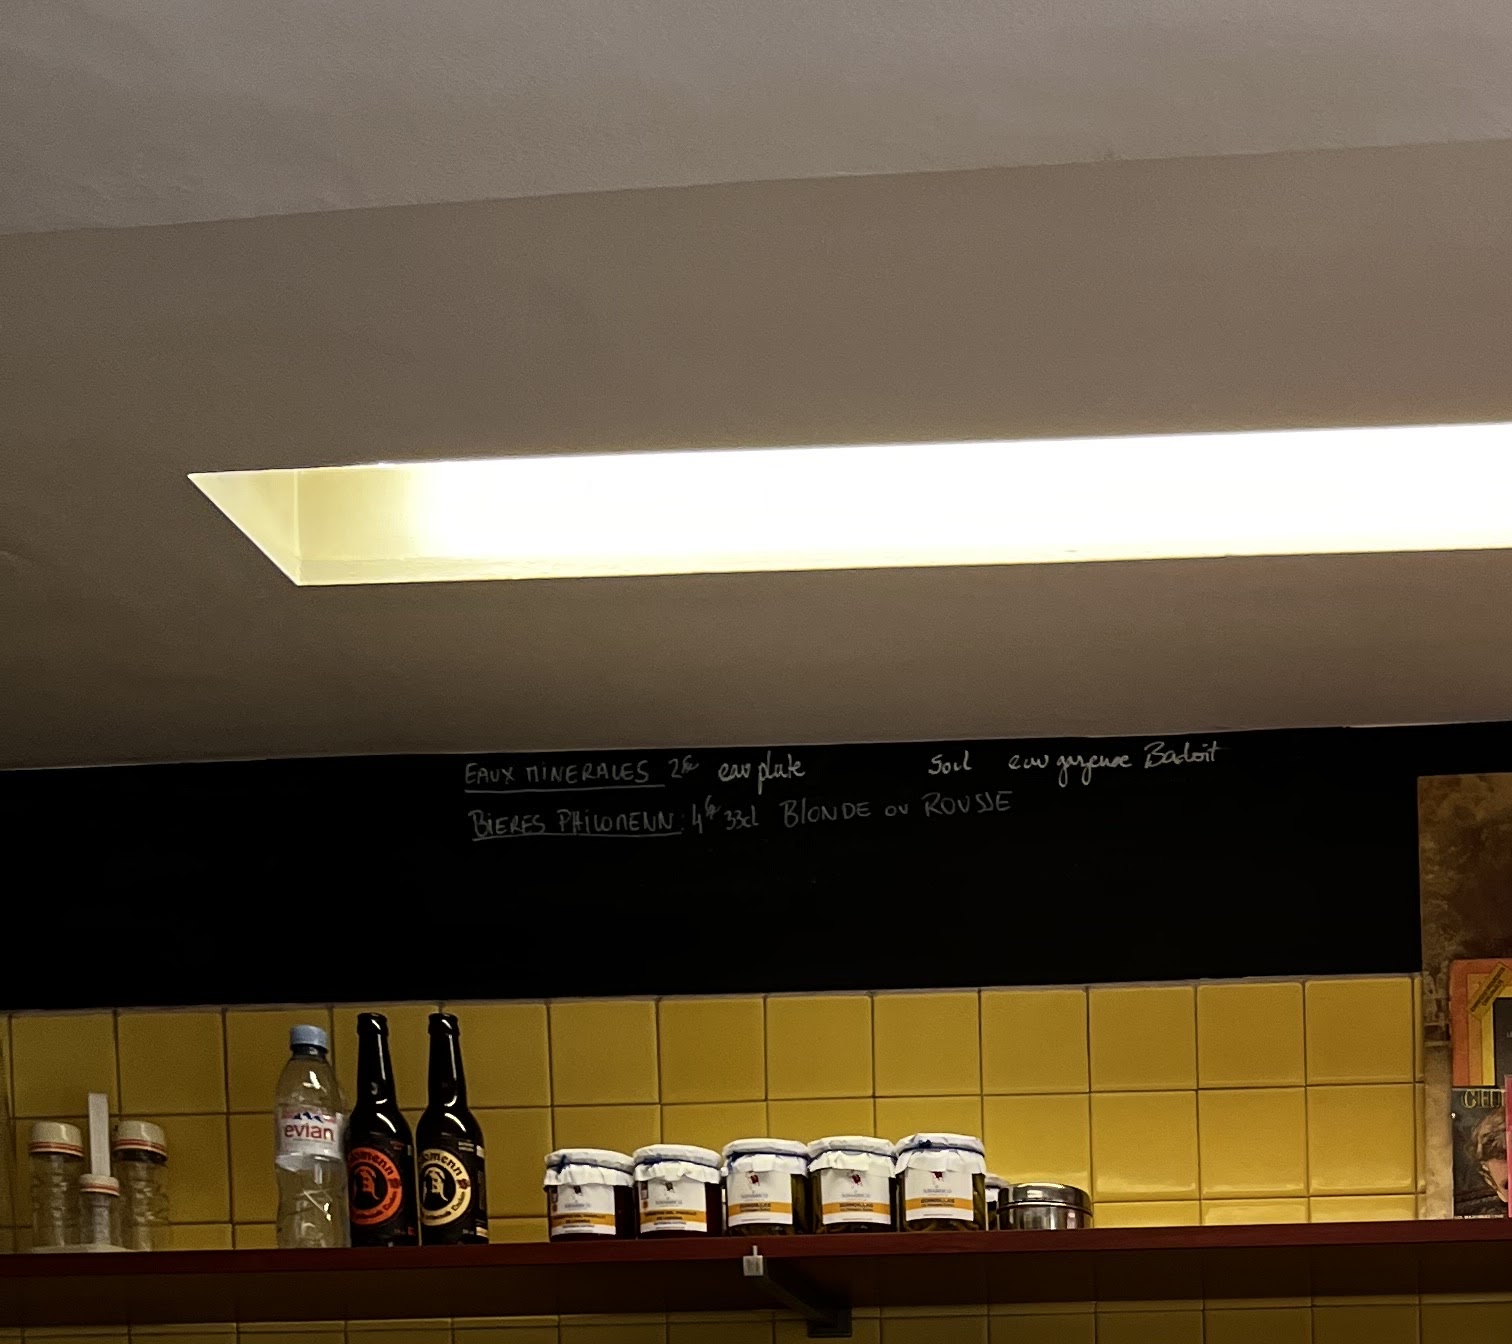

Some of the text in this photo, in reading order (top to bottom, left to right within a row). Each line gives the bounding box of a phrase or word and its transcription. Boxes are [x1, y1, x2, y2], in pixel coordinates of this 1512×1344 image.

[779, 797, 873, 829] BLONDE
[919, 789, 1014, 818] ROUSSE
[284, 1122, 335, 1142] evian
